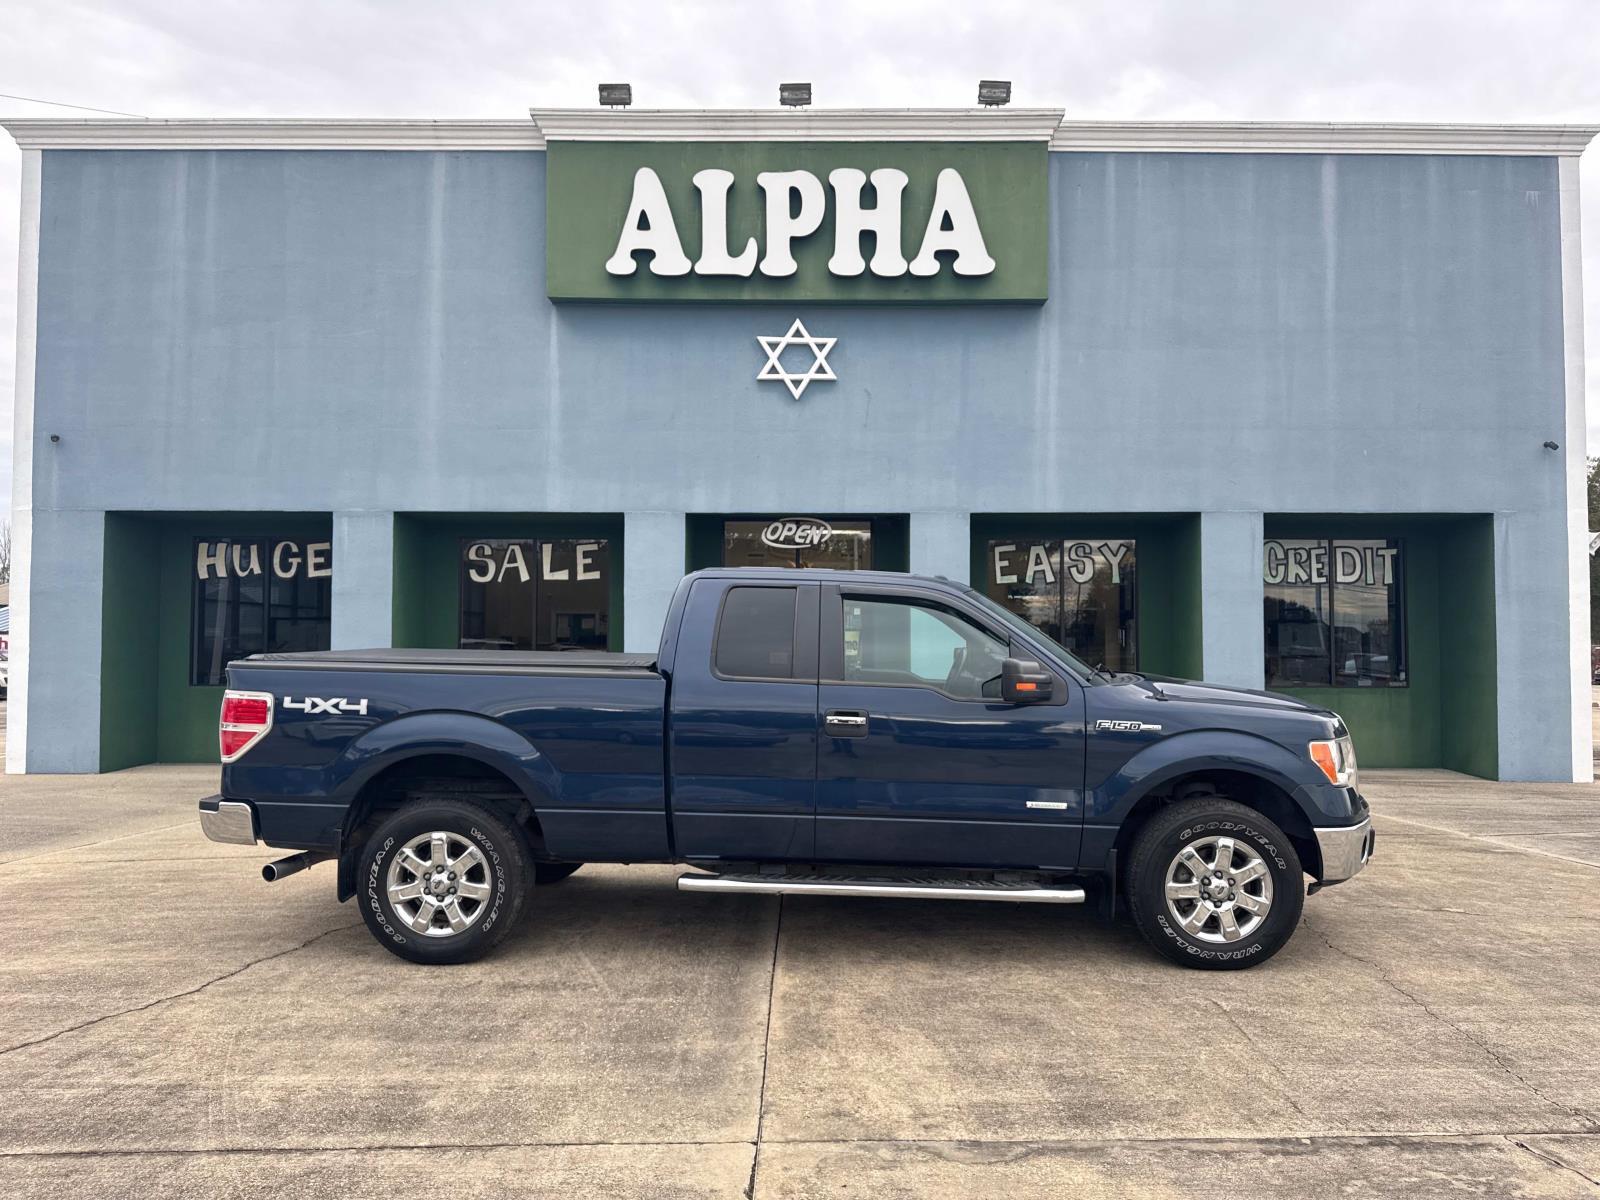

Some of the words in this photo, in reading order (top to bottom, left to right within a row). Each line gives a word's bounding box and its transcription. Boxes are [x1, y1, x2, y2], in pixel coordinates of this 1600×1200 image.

[605, 167, 996, 277] ALPHA
[766, 522, 824, 545] OPEN
[197, 541, 332, 579] HUGE
[468, 543, 600, 583] SALE
[994, 543, 1128, 584] EASY
[1264, 541, 1398, 584] CREDIT
[1096, 720, 1143, 732] F-150
[470, 827, 506, 932] WRANGLER
[1157, 914, 1262, 960] WRANGLER
